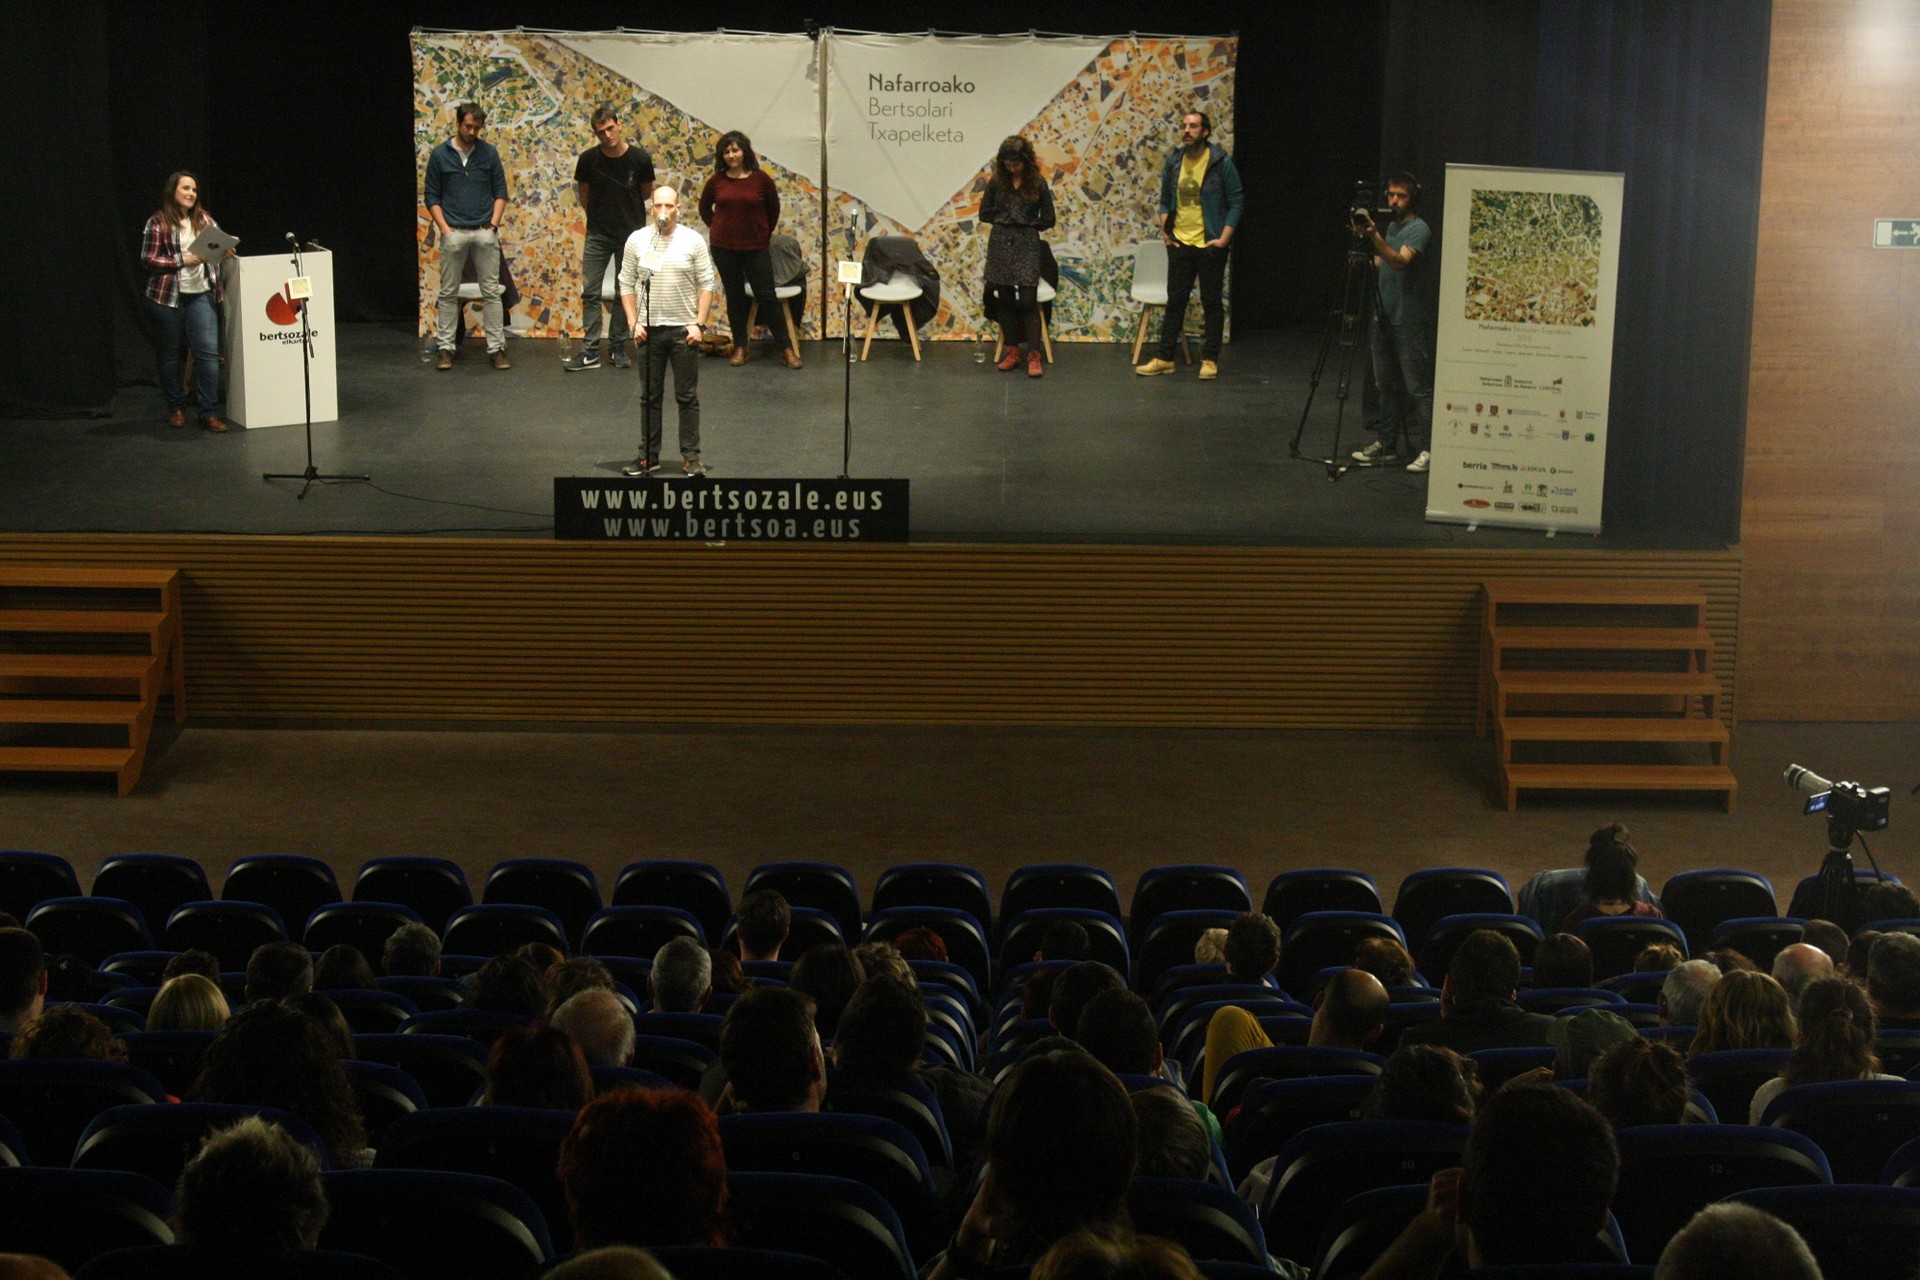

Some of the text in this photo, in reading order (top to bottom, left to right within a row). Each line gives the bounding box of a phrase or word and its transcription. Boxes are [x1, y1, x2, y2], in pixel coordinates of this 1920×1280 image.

[868, 73, 976, 94] Nafarroako
[868, 96, 953, 118] Bertsolari
[867, 121, 965, 147] Txapelketa
[259, 330, 319, 342] bertsoze
[580, 482, 883, 510] www.bertsozale.eus
[603, 511, 860, 538] www.bertsoa.eus
[1401, 1159, 1416, 1170] 10
